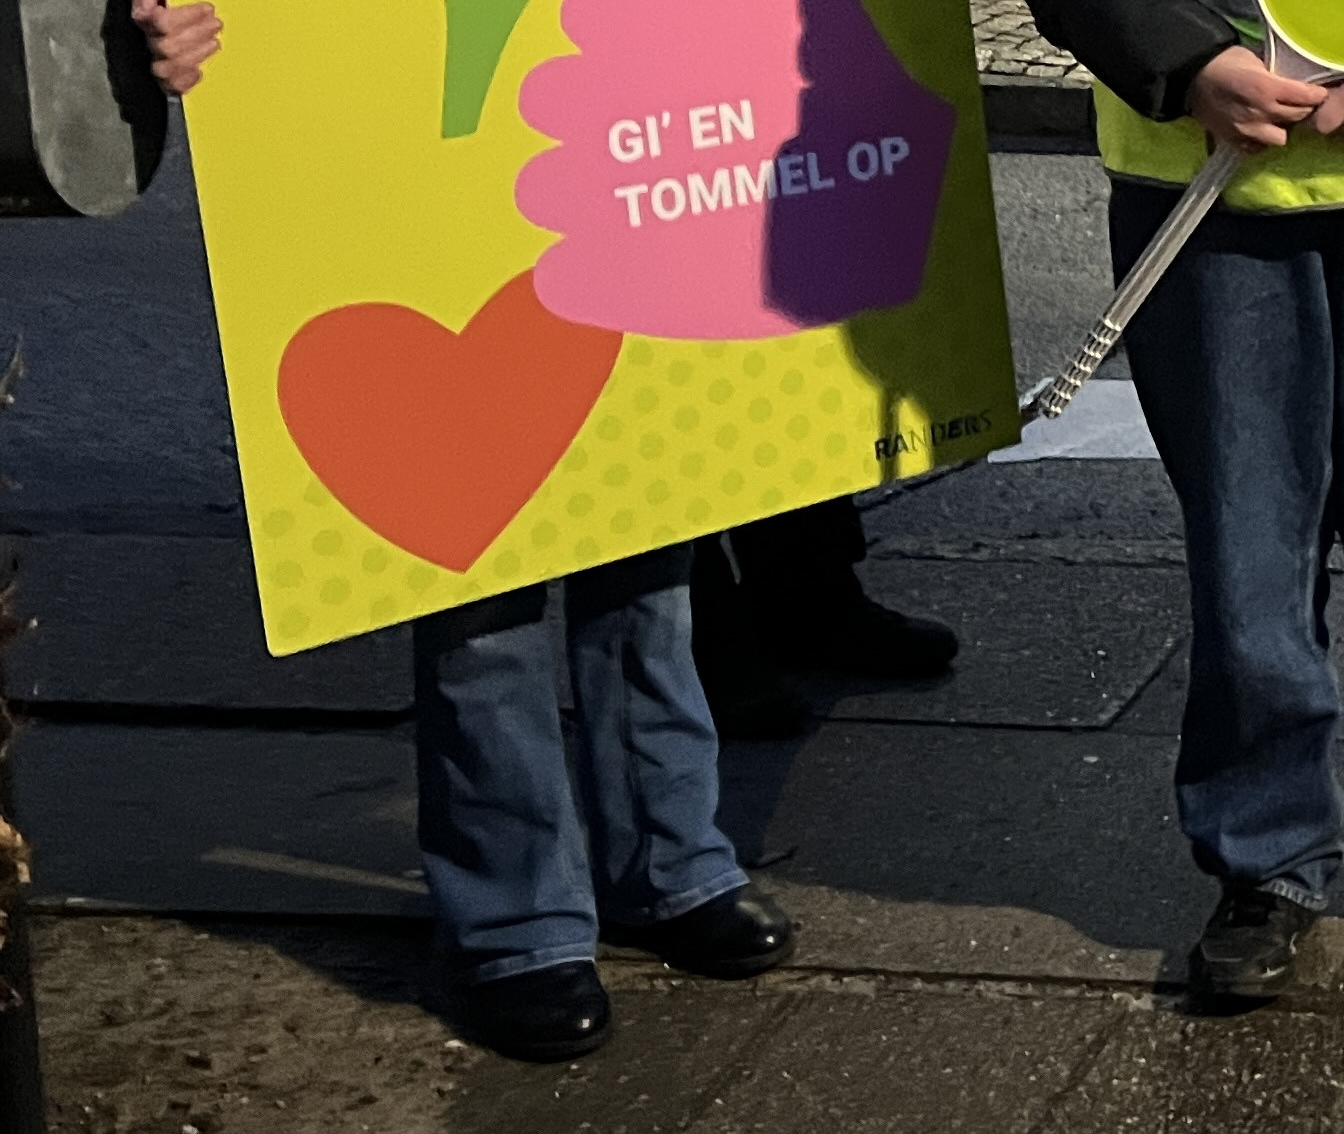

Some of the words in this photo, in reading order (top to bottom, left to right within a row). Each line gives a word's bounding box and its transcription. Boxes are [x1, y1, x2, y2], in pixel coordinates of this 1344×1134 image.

[688, 99, 755, 150] EN
[614, 152, 836, 228] TOMMEL
[847, 136, 910, 182] OP
[875, 409, 993, 462] RANDERS
